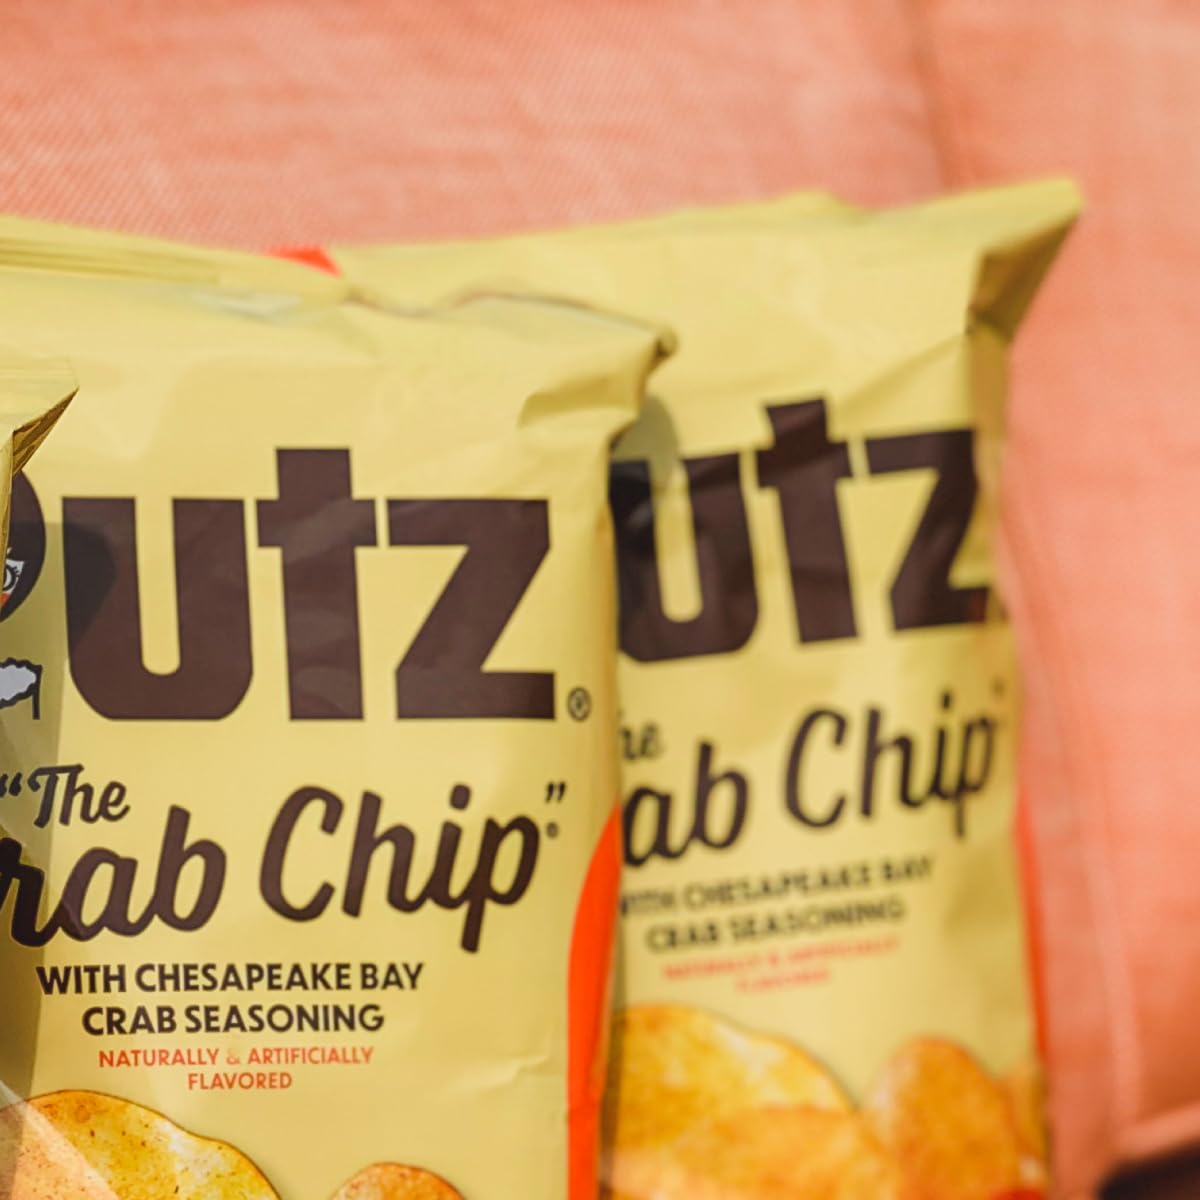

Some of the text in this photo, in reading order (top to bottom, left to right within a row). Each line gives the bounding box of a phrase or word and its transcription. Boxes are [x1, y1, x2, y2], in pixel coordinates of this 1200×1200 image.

[622, 741, 749, 868] ab
[35, 962, 425, 995] WITH CHESAPEAKE BAY
[82, 1003, 385, 1036] CRAB SEASONING
[98, 1048, 220, 1068] NATURALLY
[247, 1046, 374, 1065] ARTIFICIALLY
[187, 1072, 292, 1090] FLAVORED
